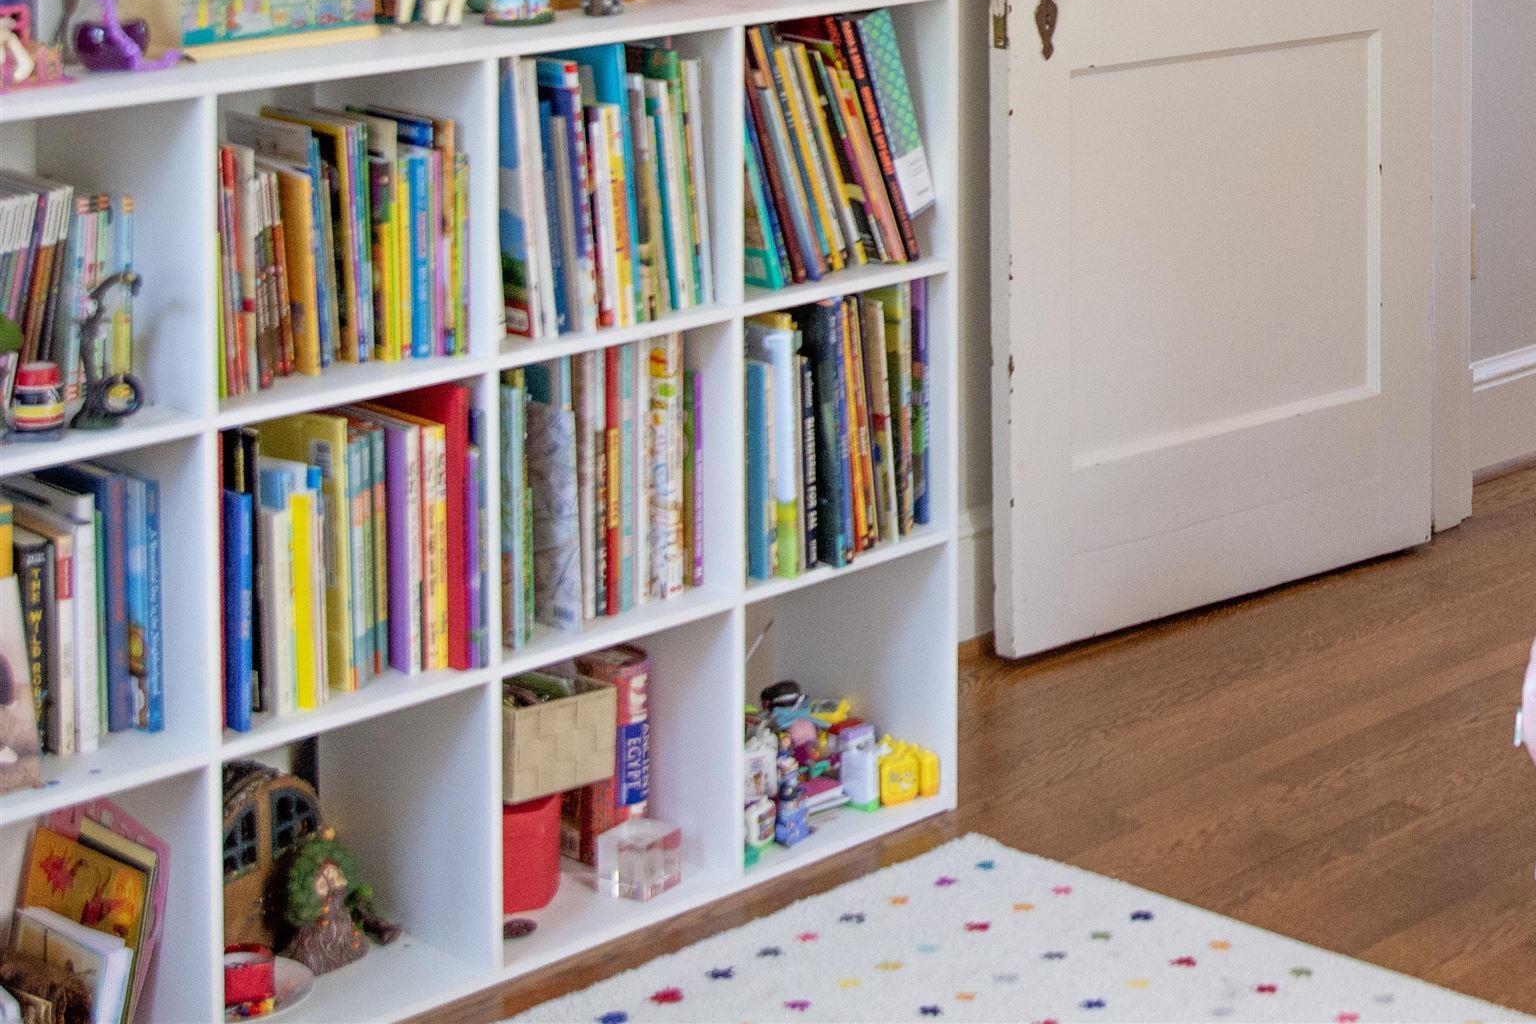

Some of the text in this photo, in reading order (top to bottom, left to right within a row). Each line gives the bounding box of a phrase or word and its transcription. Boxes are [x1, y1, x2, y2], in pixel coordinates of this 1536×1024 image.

[28, 566, 42, 605] THE
[27, 608, 43, 659] WILD
[625, 736, 642, 791] EGYPT
